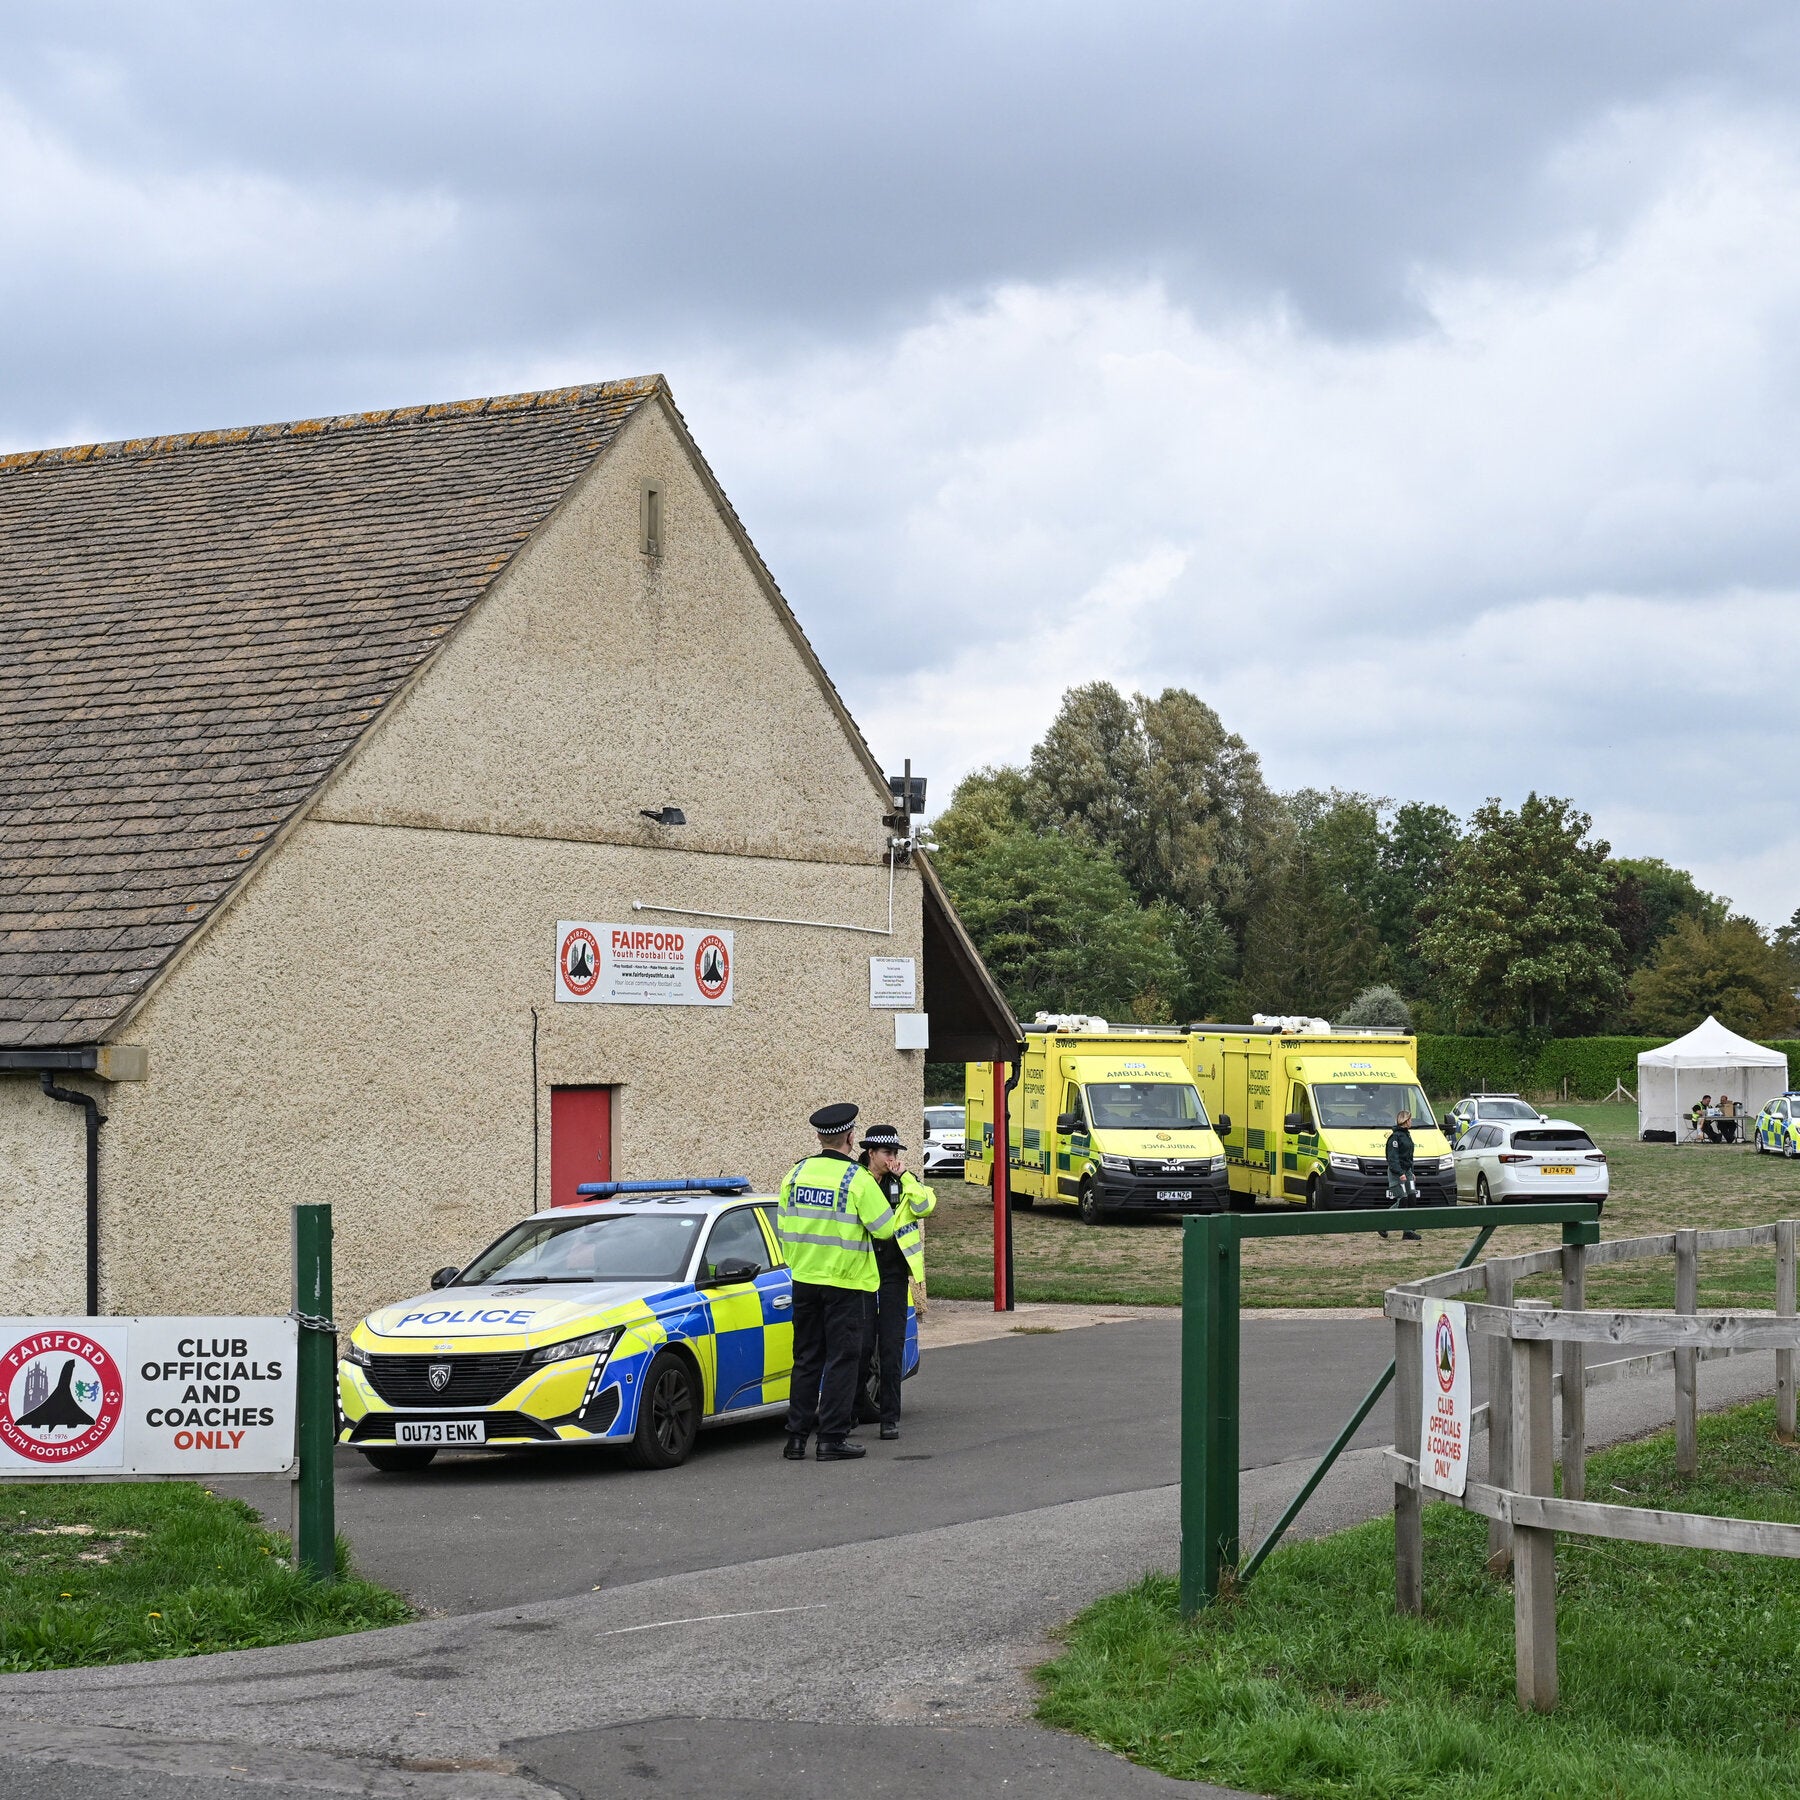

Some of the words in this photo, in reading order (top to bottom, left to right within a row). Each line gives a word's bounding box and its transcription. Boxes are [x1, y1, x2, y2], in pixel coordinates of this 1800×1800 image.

[567, 930, 596, 947] FAIRFORD
[612, 931, 684, 951] FAIRFORD
[699, 937, 725, 953] FAIRFORD
[612, 950, 633, 958] Youth
[636, 951, 666, 960] Football
[668, 952, 684, 960] Club
[1026, 1068, 1044, 1079] INCIDENT
[1106, 1071, 1173, 1079] AMBULANCE
[1250, 1069, 1269, 1080] INCIDENT
[1333, 1071, 1398, 1079] AMBULANCE
[1024, 1083, 1045, 1095] RESPONSE
[1248, 1084, 1271, 1096] RESPONSE
[1030, 1099, 1039, 1110] UNIT
[1254, 1100, 1264, 1110] UNIT
[1543, 1166, 1560, 1174] WJ74
[1560, 1166, 1573, 1174] FZK
[797, 1188, 833, 1205] POLICE
[396, 1309, 536, 1329] POLICE
[8, 1335, 105, 1367] FAIRFORD
[178, 1338, 248, 1358] CLUB
[140, 1361, 283, 1381] OFFICIALS
[181, 1385, 240, 1404] AND
[1437, 1396, 1454, 1416] CLUB
[146, 1407, 274, 1427] COACHES
[0, 1415, 29, 1449] YOUTH
[29, 1442, 90, 1457] FOOTBALL
[89, 1415, 112, 1441] CLUB
[402, 1425, 442, 1442] OU73
[446, 1423, 478, 1441] ENK
[1429, 1415, 1462, 1440] OFFICIALS
[174, 1430, 246, 1450] ONLY
[1427, 1435, 1433, 1451] &
[1432, 1437, 1462, 1461] COACHES
[1434, 1458, 1452, 1479] ONLY
